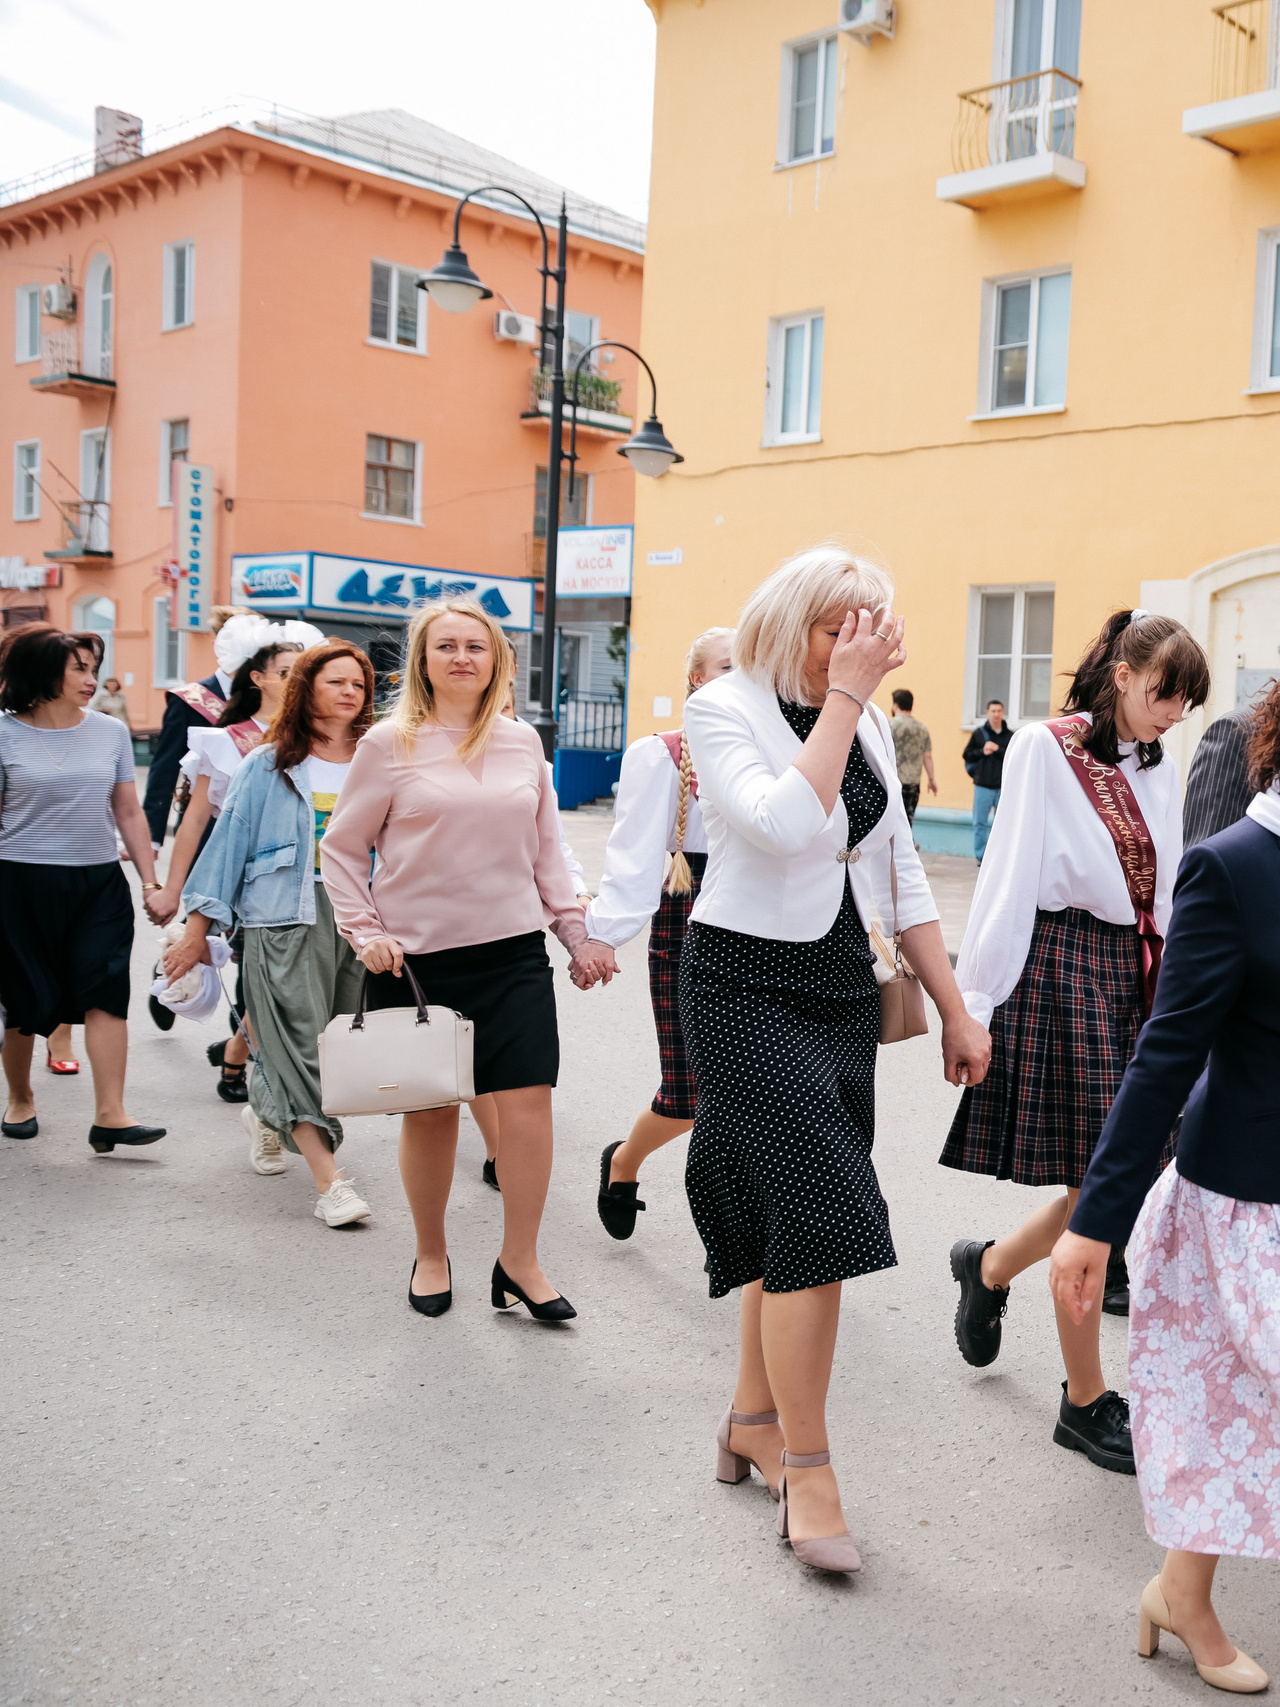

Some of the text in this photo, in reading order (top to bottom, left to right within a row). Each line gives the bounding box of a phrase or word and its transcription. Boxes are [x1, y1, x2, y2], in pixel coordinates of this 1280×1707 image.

[188, 469, 202, 627] СТОМАТОЛОГИЯ
[576, 556, 613, 570] КАССА
[563, 577, 577, 590] НА
[1084, 757, 1138, 874] Выпускница
